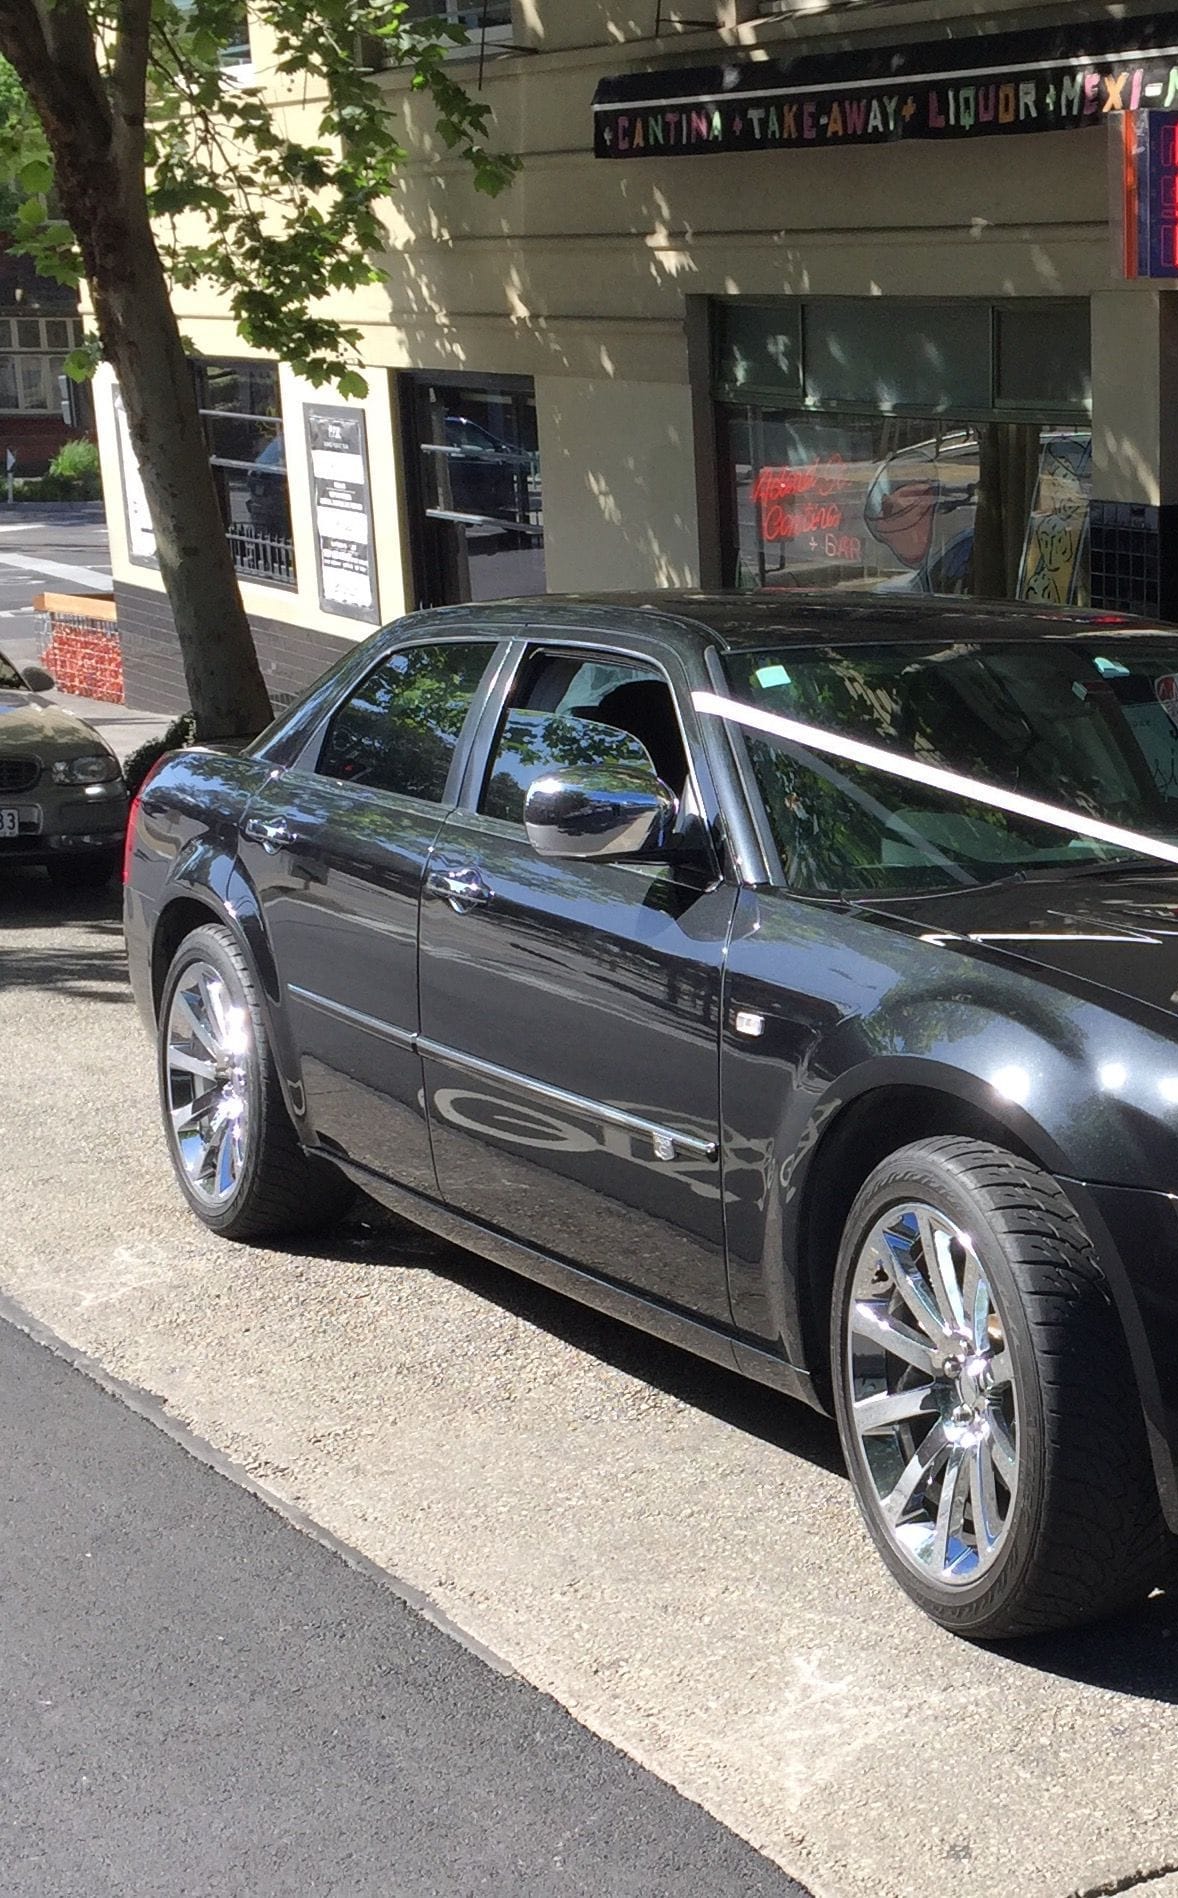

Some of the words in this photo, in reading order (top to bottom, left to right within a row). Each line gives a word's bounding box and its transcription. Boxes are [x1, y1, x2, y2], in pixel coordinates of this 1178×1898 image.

[617, 110, 723, 150] CANTINA
[747, 96, 900, 140] TAKE-AWAY
[928, 82, 1037, 130] LIQUOR
